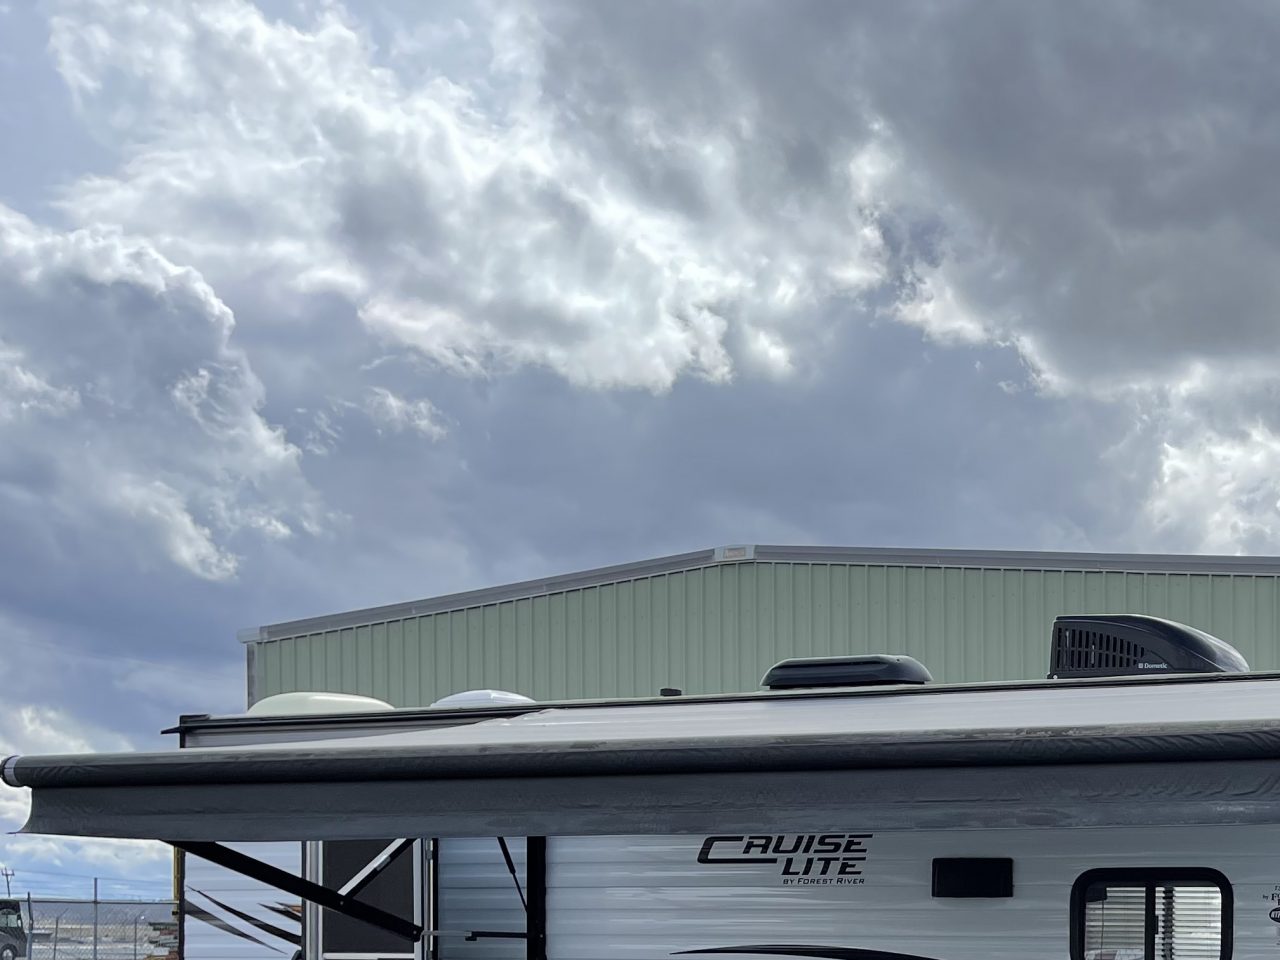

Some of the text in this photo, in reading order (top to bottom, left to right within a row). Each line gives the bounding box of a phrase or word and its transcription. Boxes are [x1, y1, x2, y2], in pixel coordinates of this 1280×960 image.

[697, 834, 873, 864] CRUISE
[781, 857, 866, 876] LITE
[797, 877, 834, 885] FOREST
[836, 877, 865, 885] RIVER
